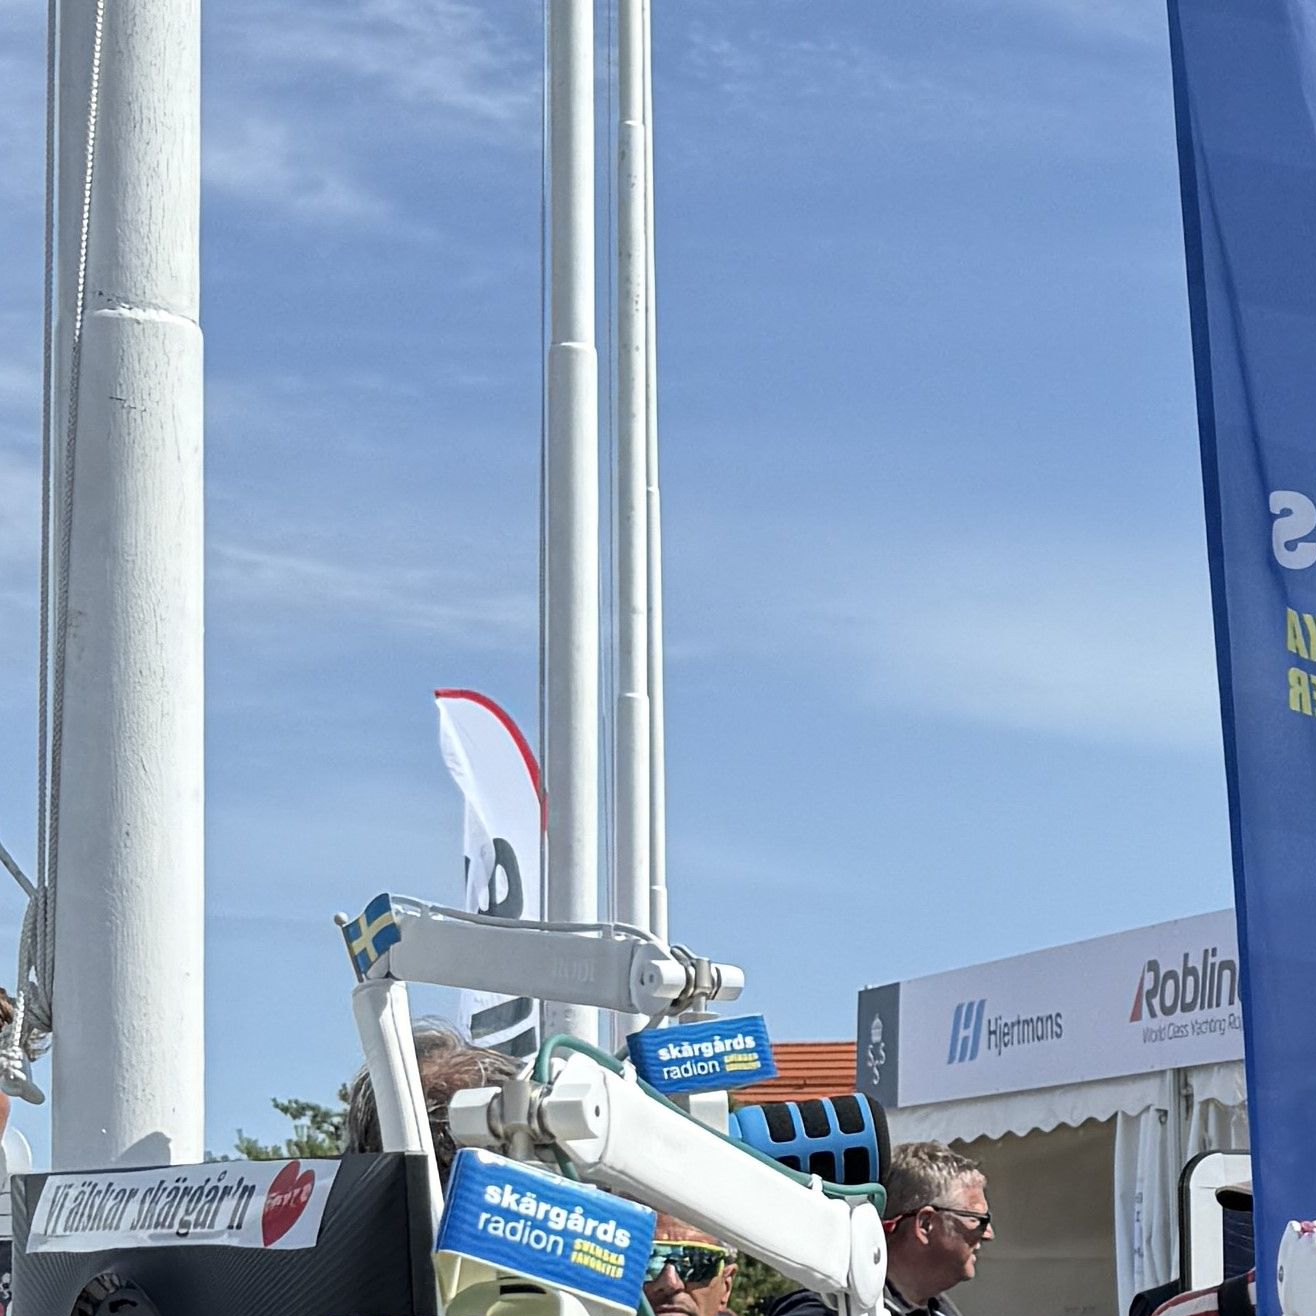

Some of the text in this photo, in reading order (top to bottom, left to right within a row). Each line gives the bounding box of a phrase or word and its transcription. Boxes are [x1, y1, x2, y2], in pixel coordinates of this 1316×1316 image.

[1129, 947, 1239, 1023] Roblin
[657, 1033, 756, 1061] skärgårds
[987, 1012, 1063, 1056] Hjertmans
[662, 1059, 720, 1080] radion
[62, 1181, 137, 1234] älskar
[483, 1183, 632, 1249] skärgårds
[477, 1211, 564, 1256] radion
